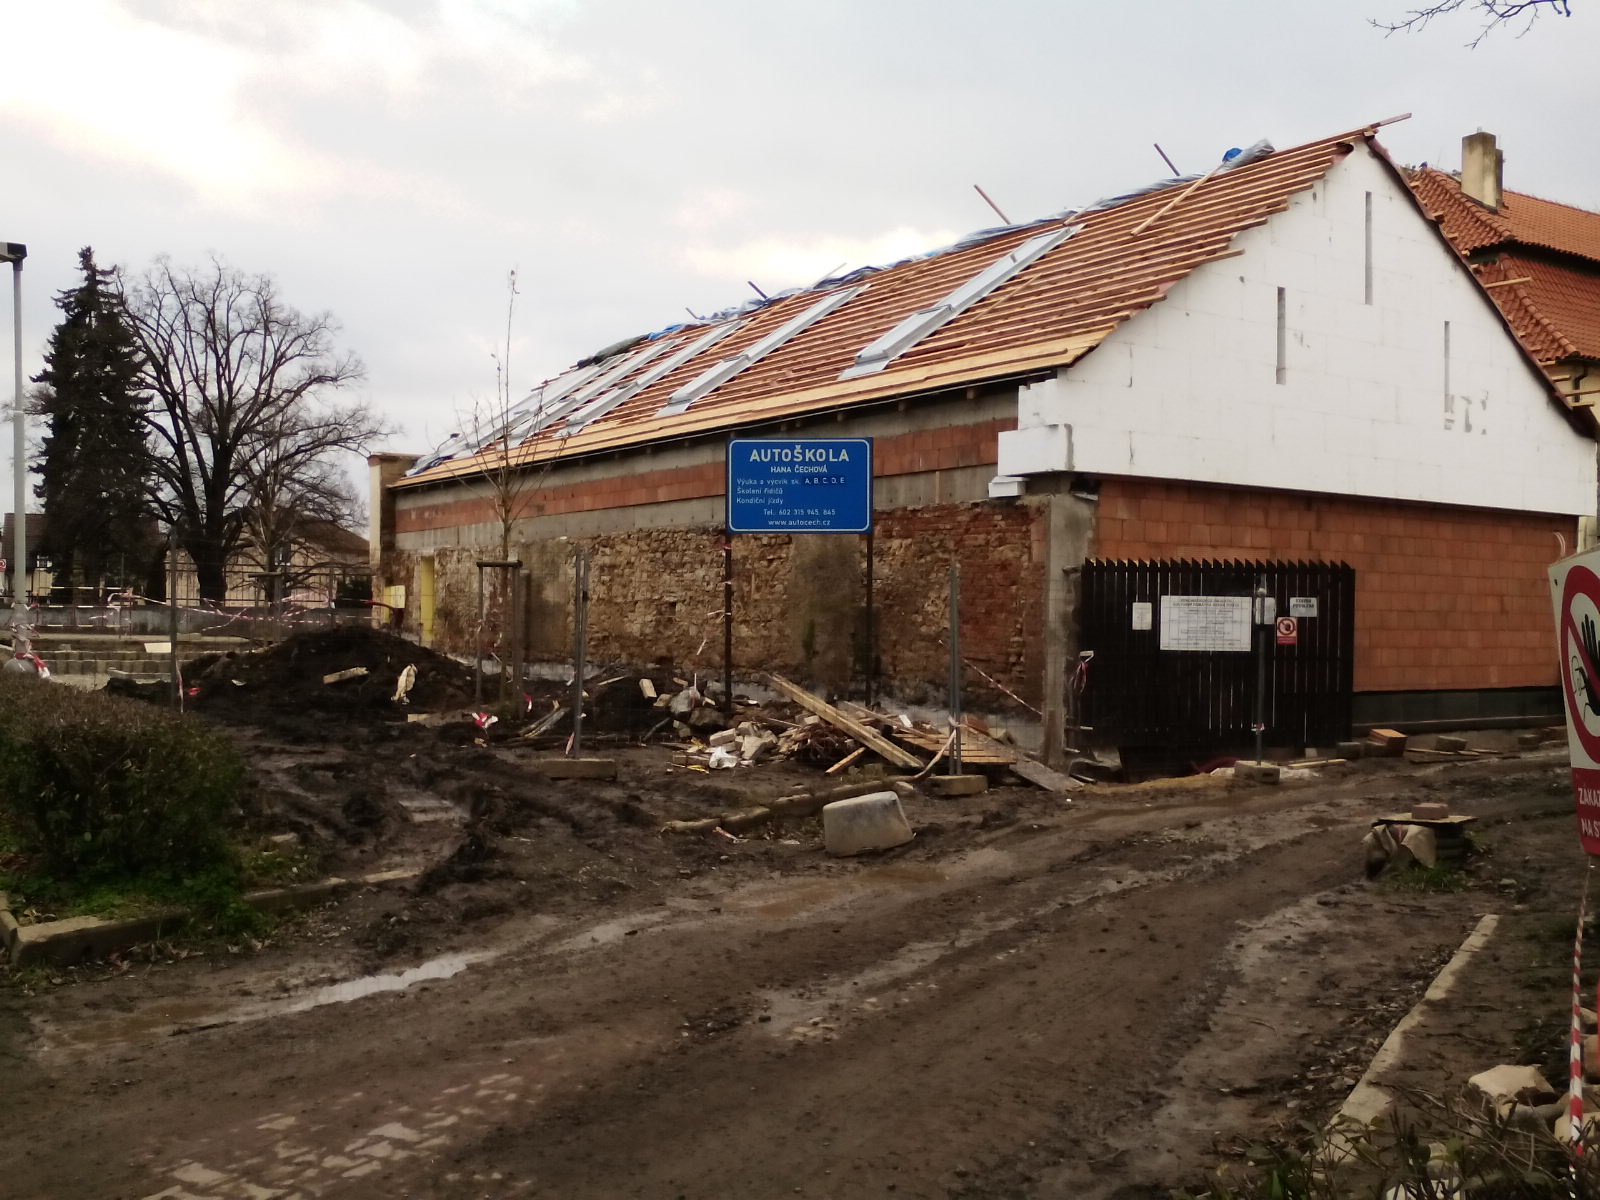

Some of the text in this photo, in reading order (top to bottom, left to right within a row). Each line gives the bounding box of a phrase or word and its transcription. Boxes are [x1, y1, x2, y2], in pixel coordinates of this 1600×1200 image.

[749, 444, 850, 462] AUTOŠKOLA
[794, 464, 828, 473] ČECHOVÁ
[736, 485, 762, 494] Školení
[767, 497, 784, 505] jízdy
[778, 508, 791, 516] 602
[793, 508, 805, 516] 315
